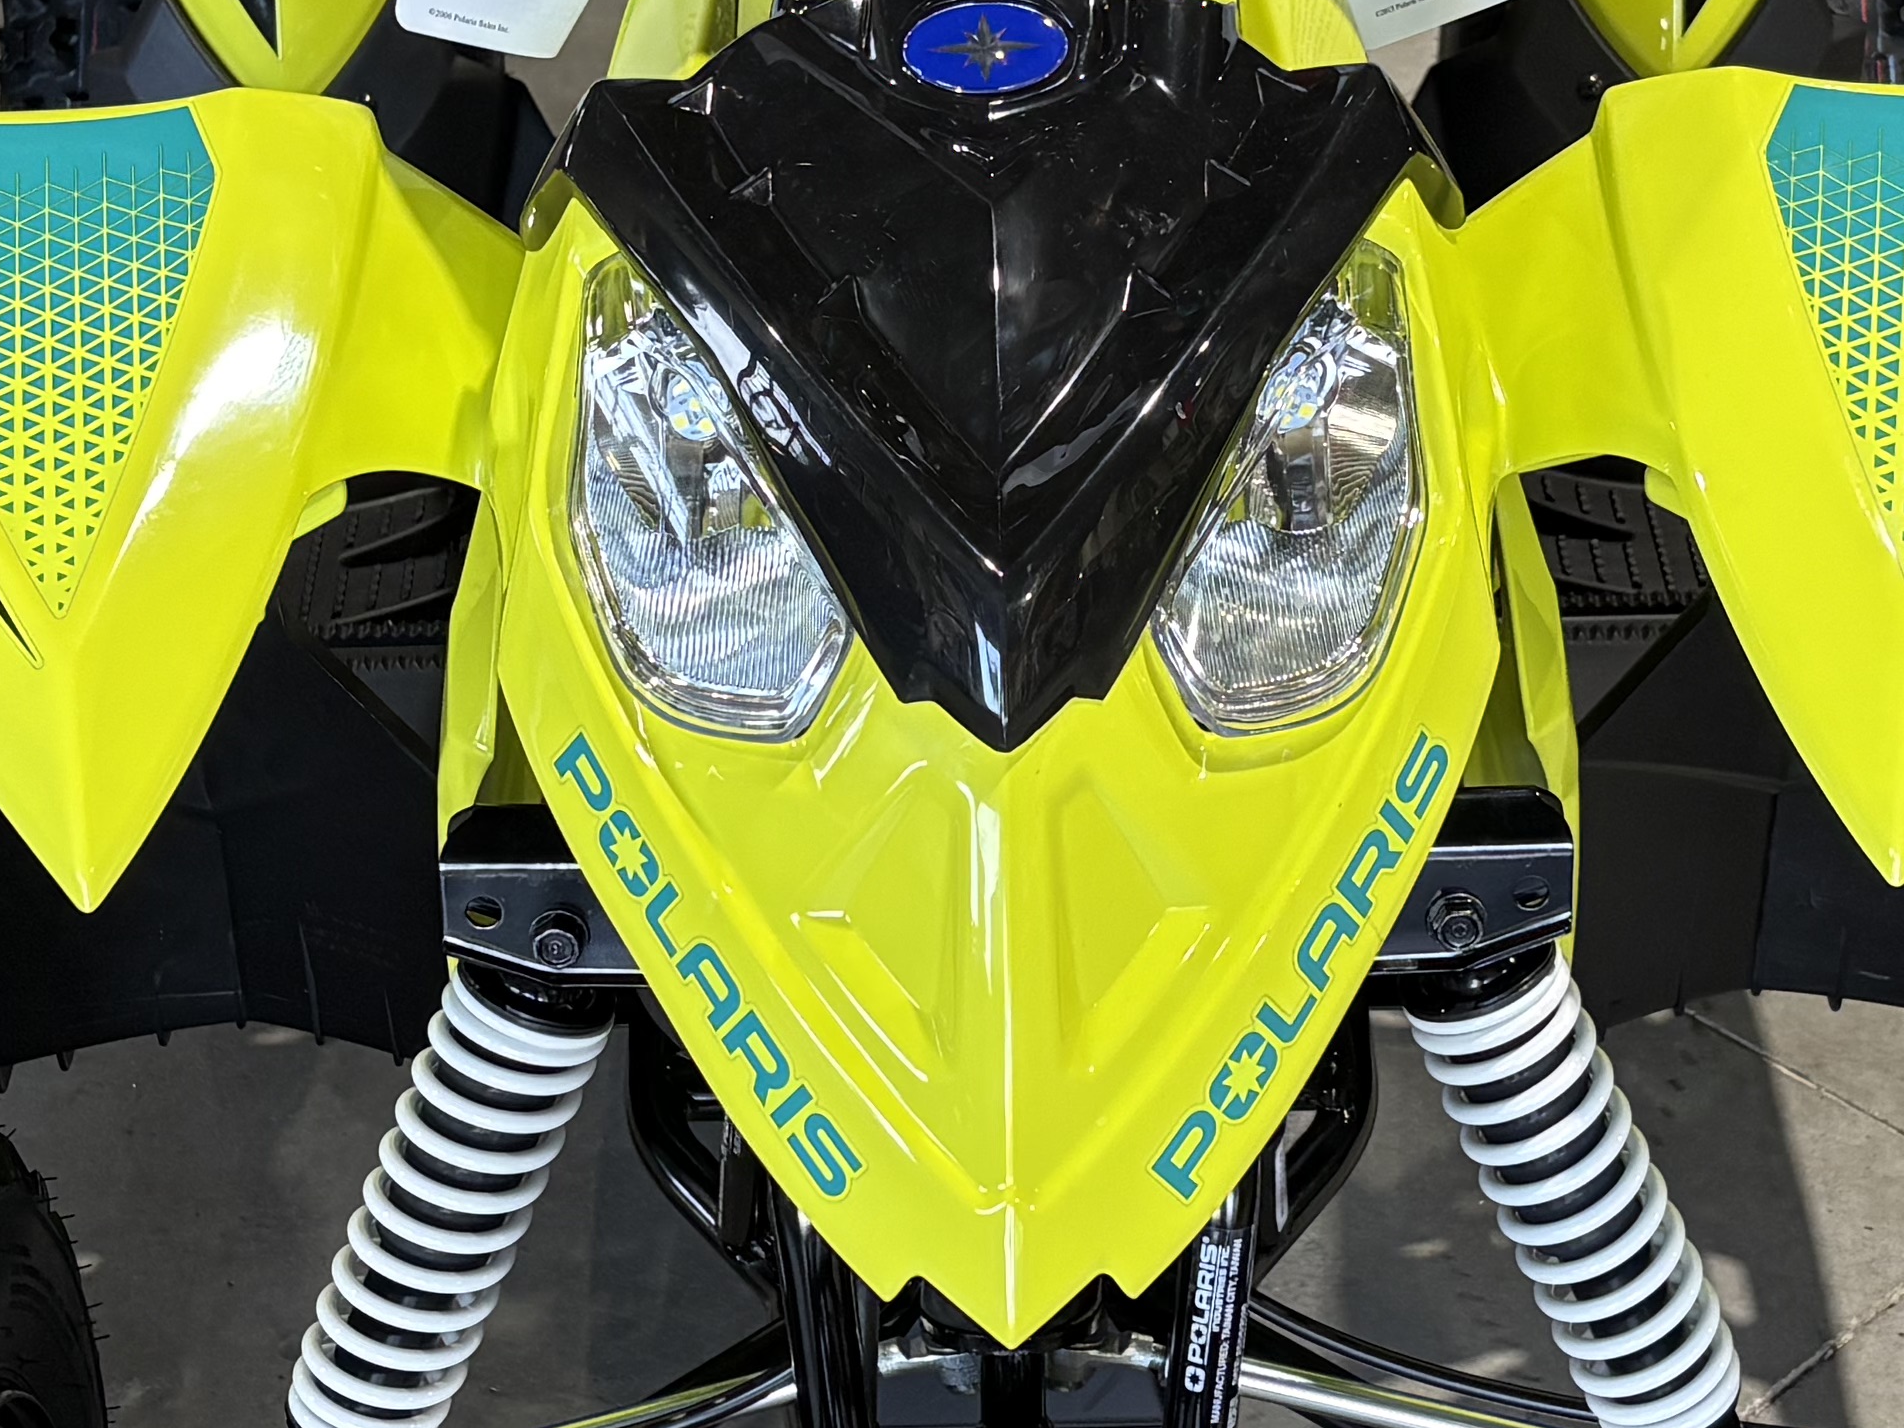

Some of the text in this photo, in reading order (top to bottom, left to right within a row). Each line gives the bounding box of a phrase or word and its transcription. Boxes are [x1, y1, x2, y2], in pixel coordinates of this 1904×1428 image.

[552, 729, 864, 1200] POLARIS
[1151, 730, 1449, 1204] POLARIS
[1210, 1340, 1231, 1424] MANUFACTURED:
